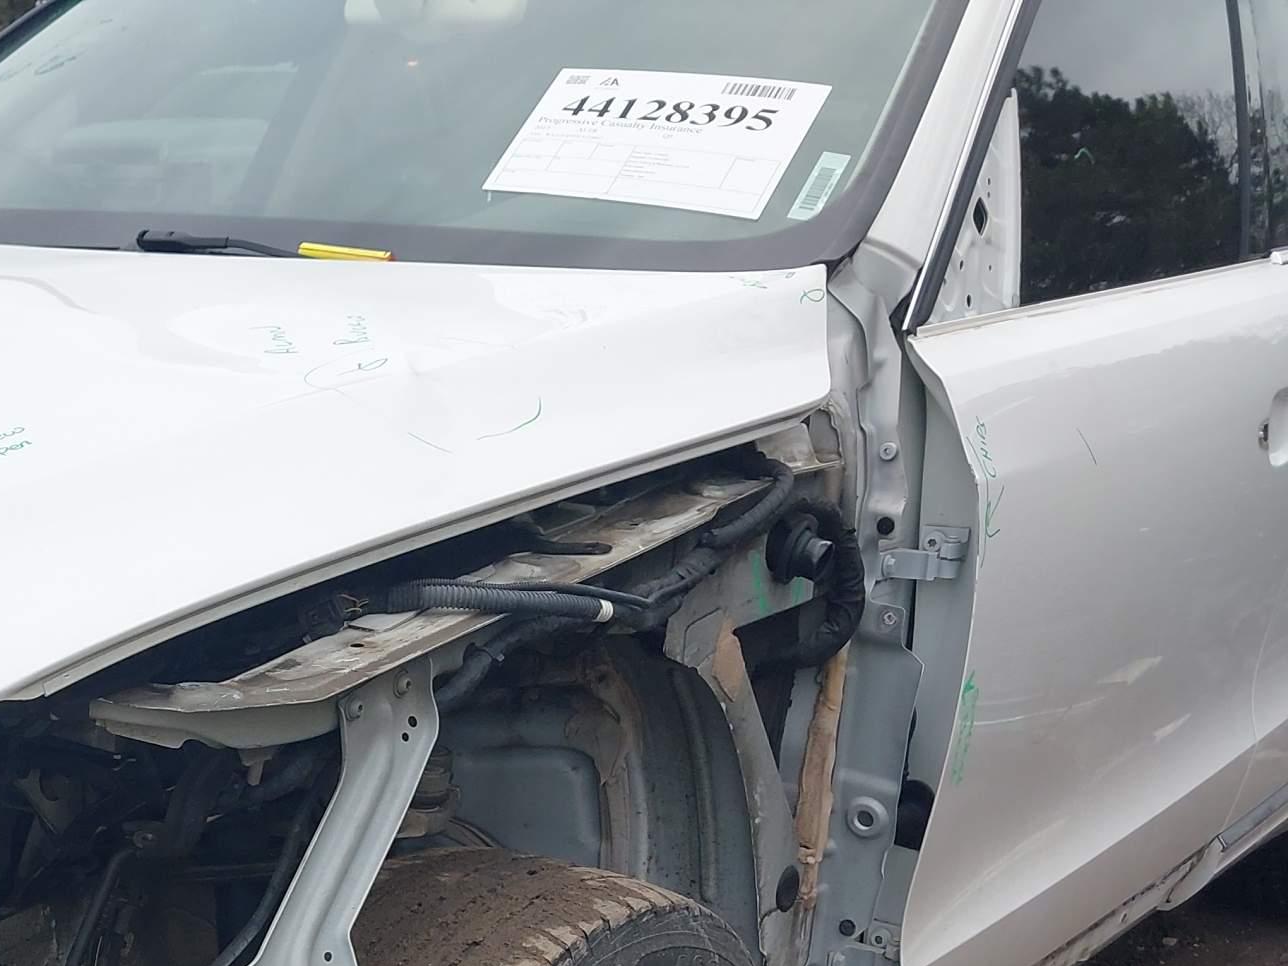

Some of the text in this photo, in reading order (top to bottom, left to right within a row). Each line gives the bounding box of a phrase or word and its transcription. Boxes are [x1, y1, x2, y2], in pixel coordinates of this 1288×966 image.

[537, 116, 598, 128] Progressive
[600, 119, 646, 132] Casualty
[648, 121, 704, 134] Insurance
[562, 95, 778, 131] 44128395
